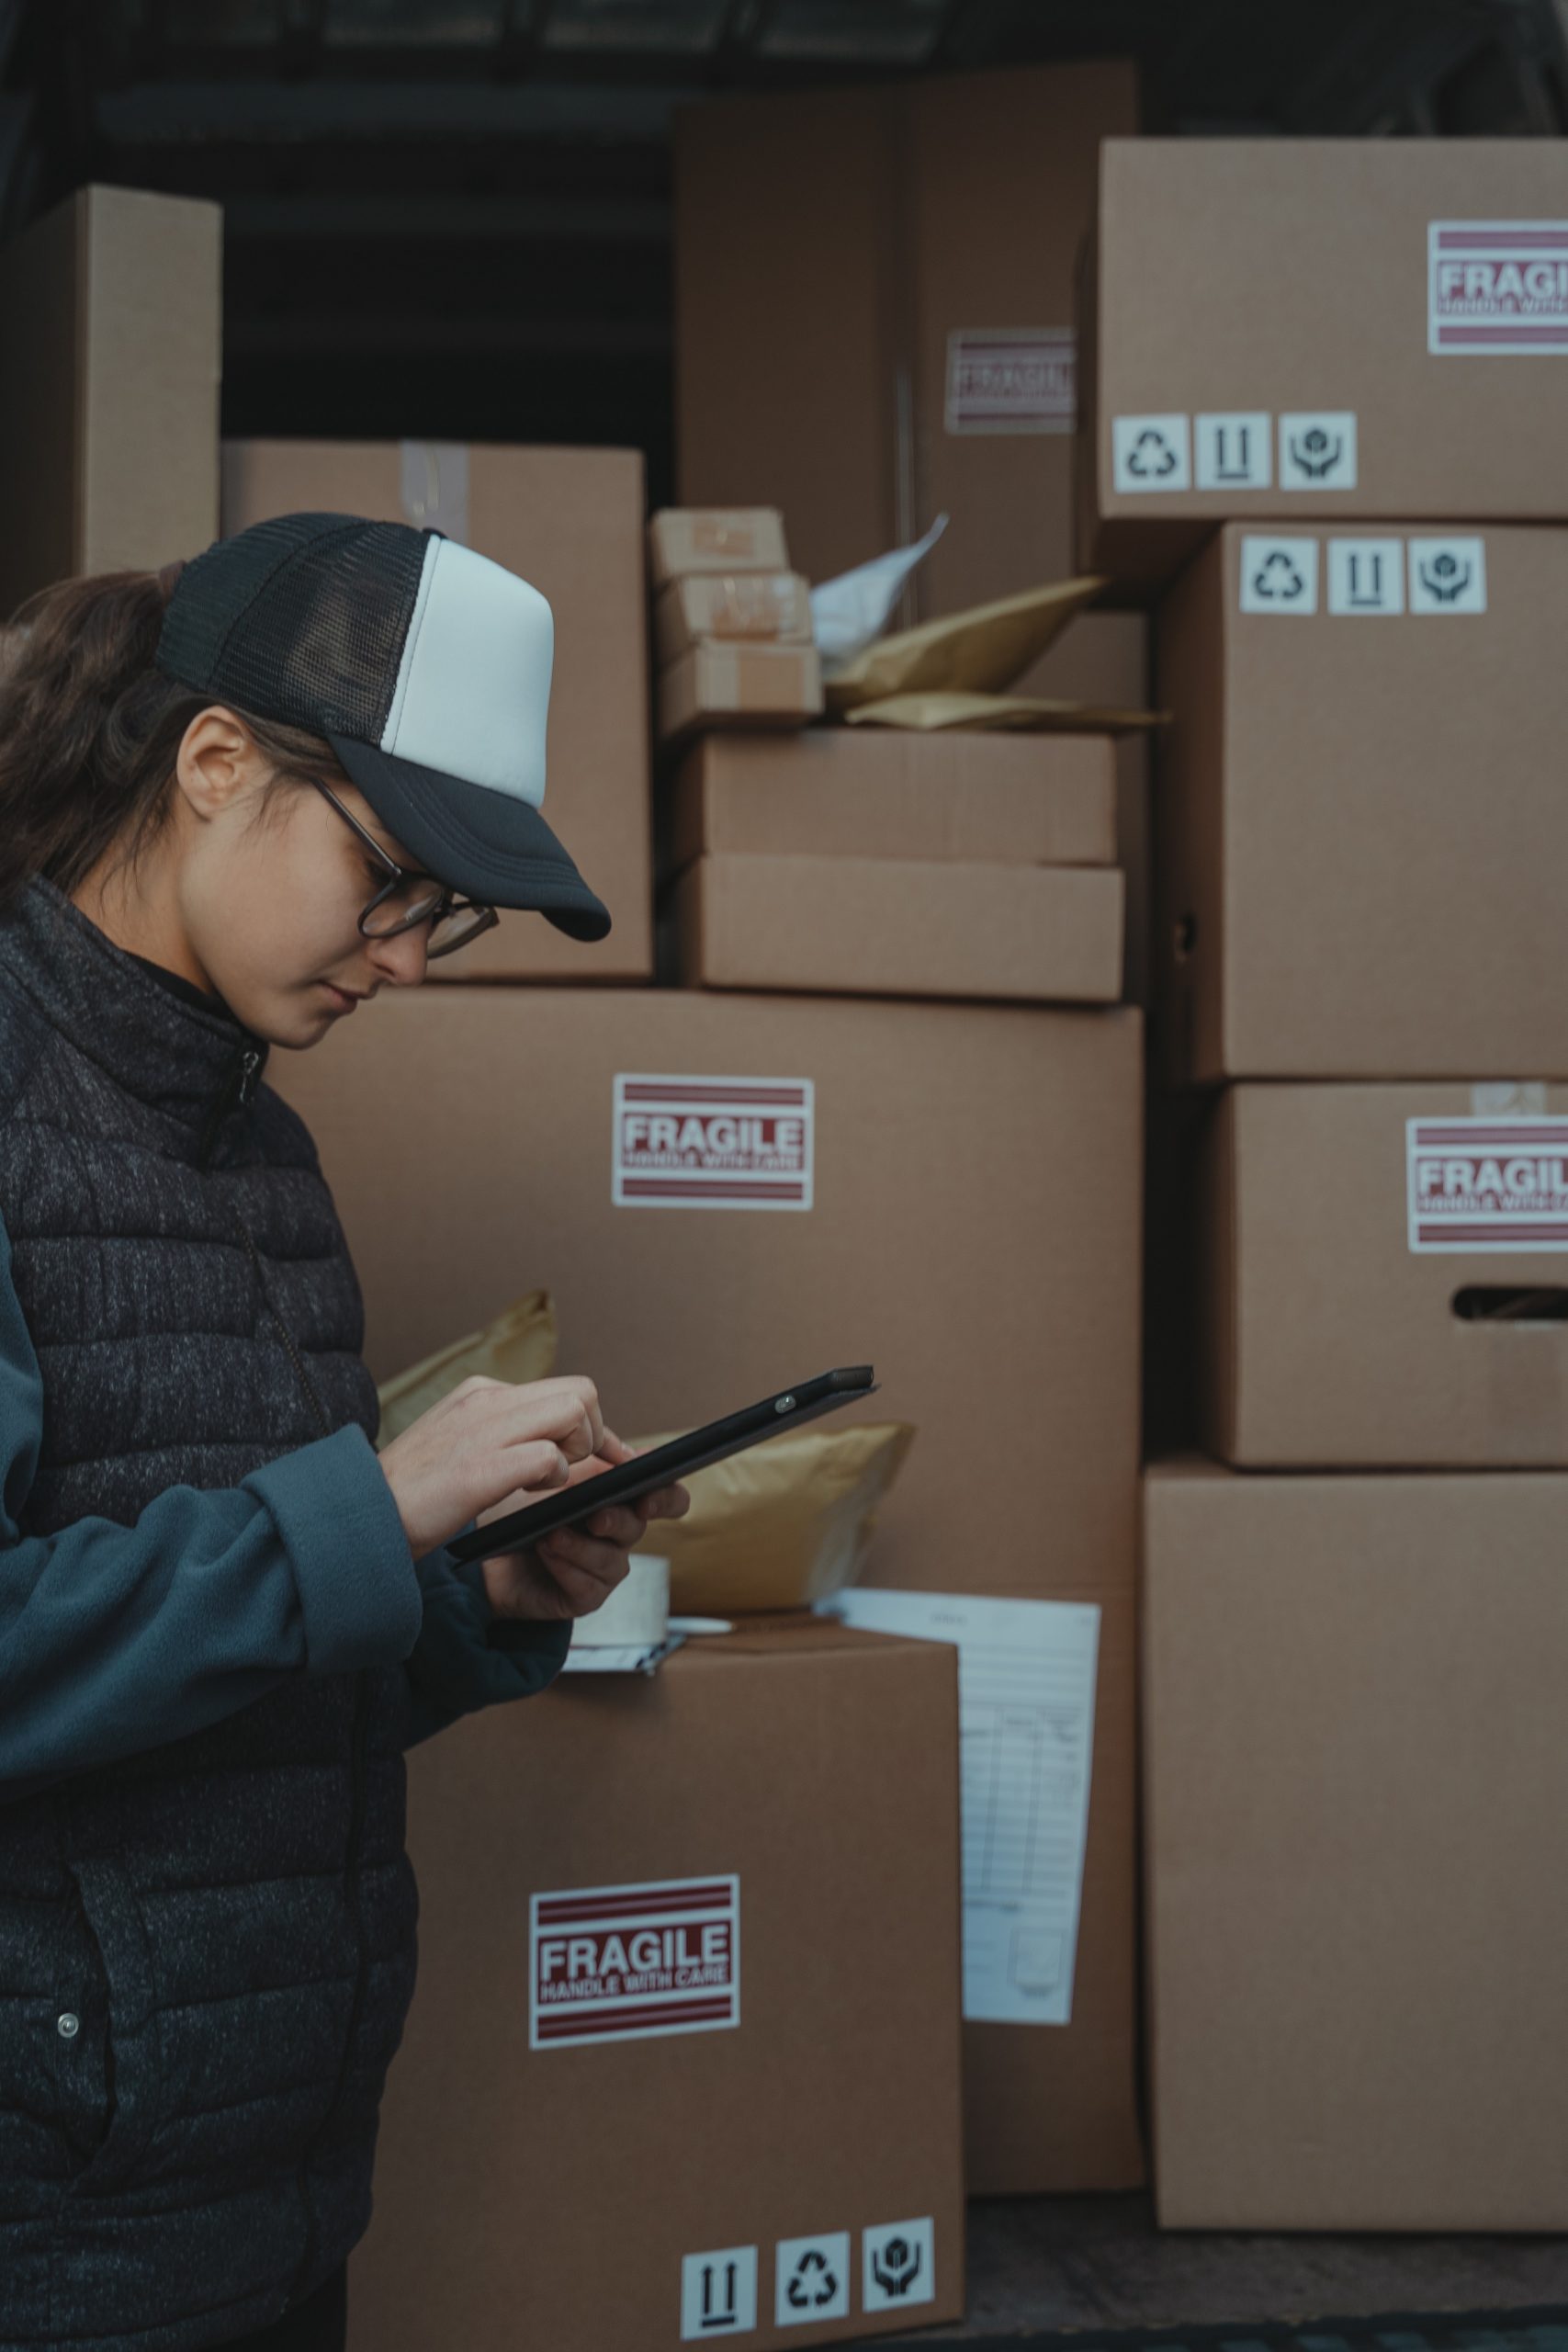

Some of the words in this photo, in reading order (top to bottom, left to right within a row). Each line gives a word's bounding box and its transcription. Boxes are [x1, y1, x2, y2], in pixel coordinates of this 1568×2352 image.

[625, 1114, 802, 1153] FRAGILE
[540, 1924, 729, 1982] FRAGILE
[540, 1974, 622, 2002] HANDLE
[624, 1970, 673, 1992] WITH
[675, 1964, 728, 1987] CARE
